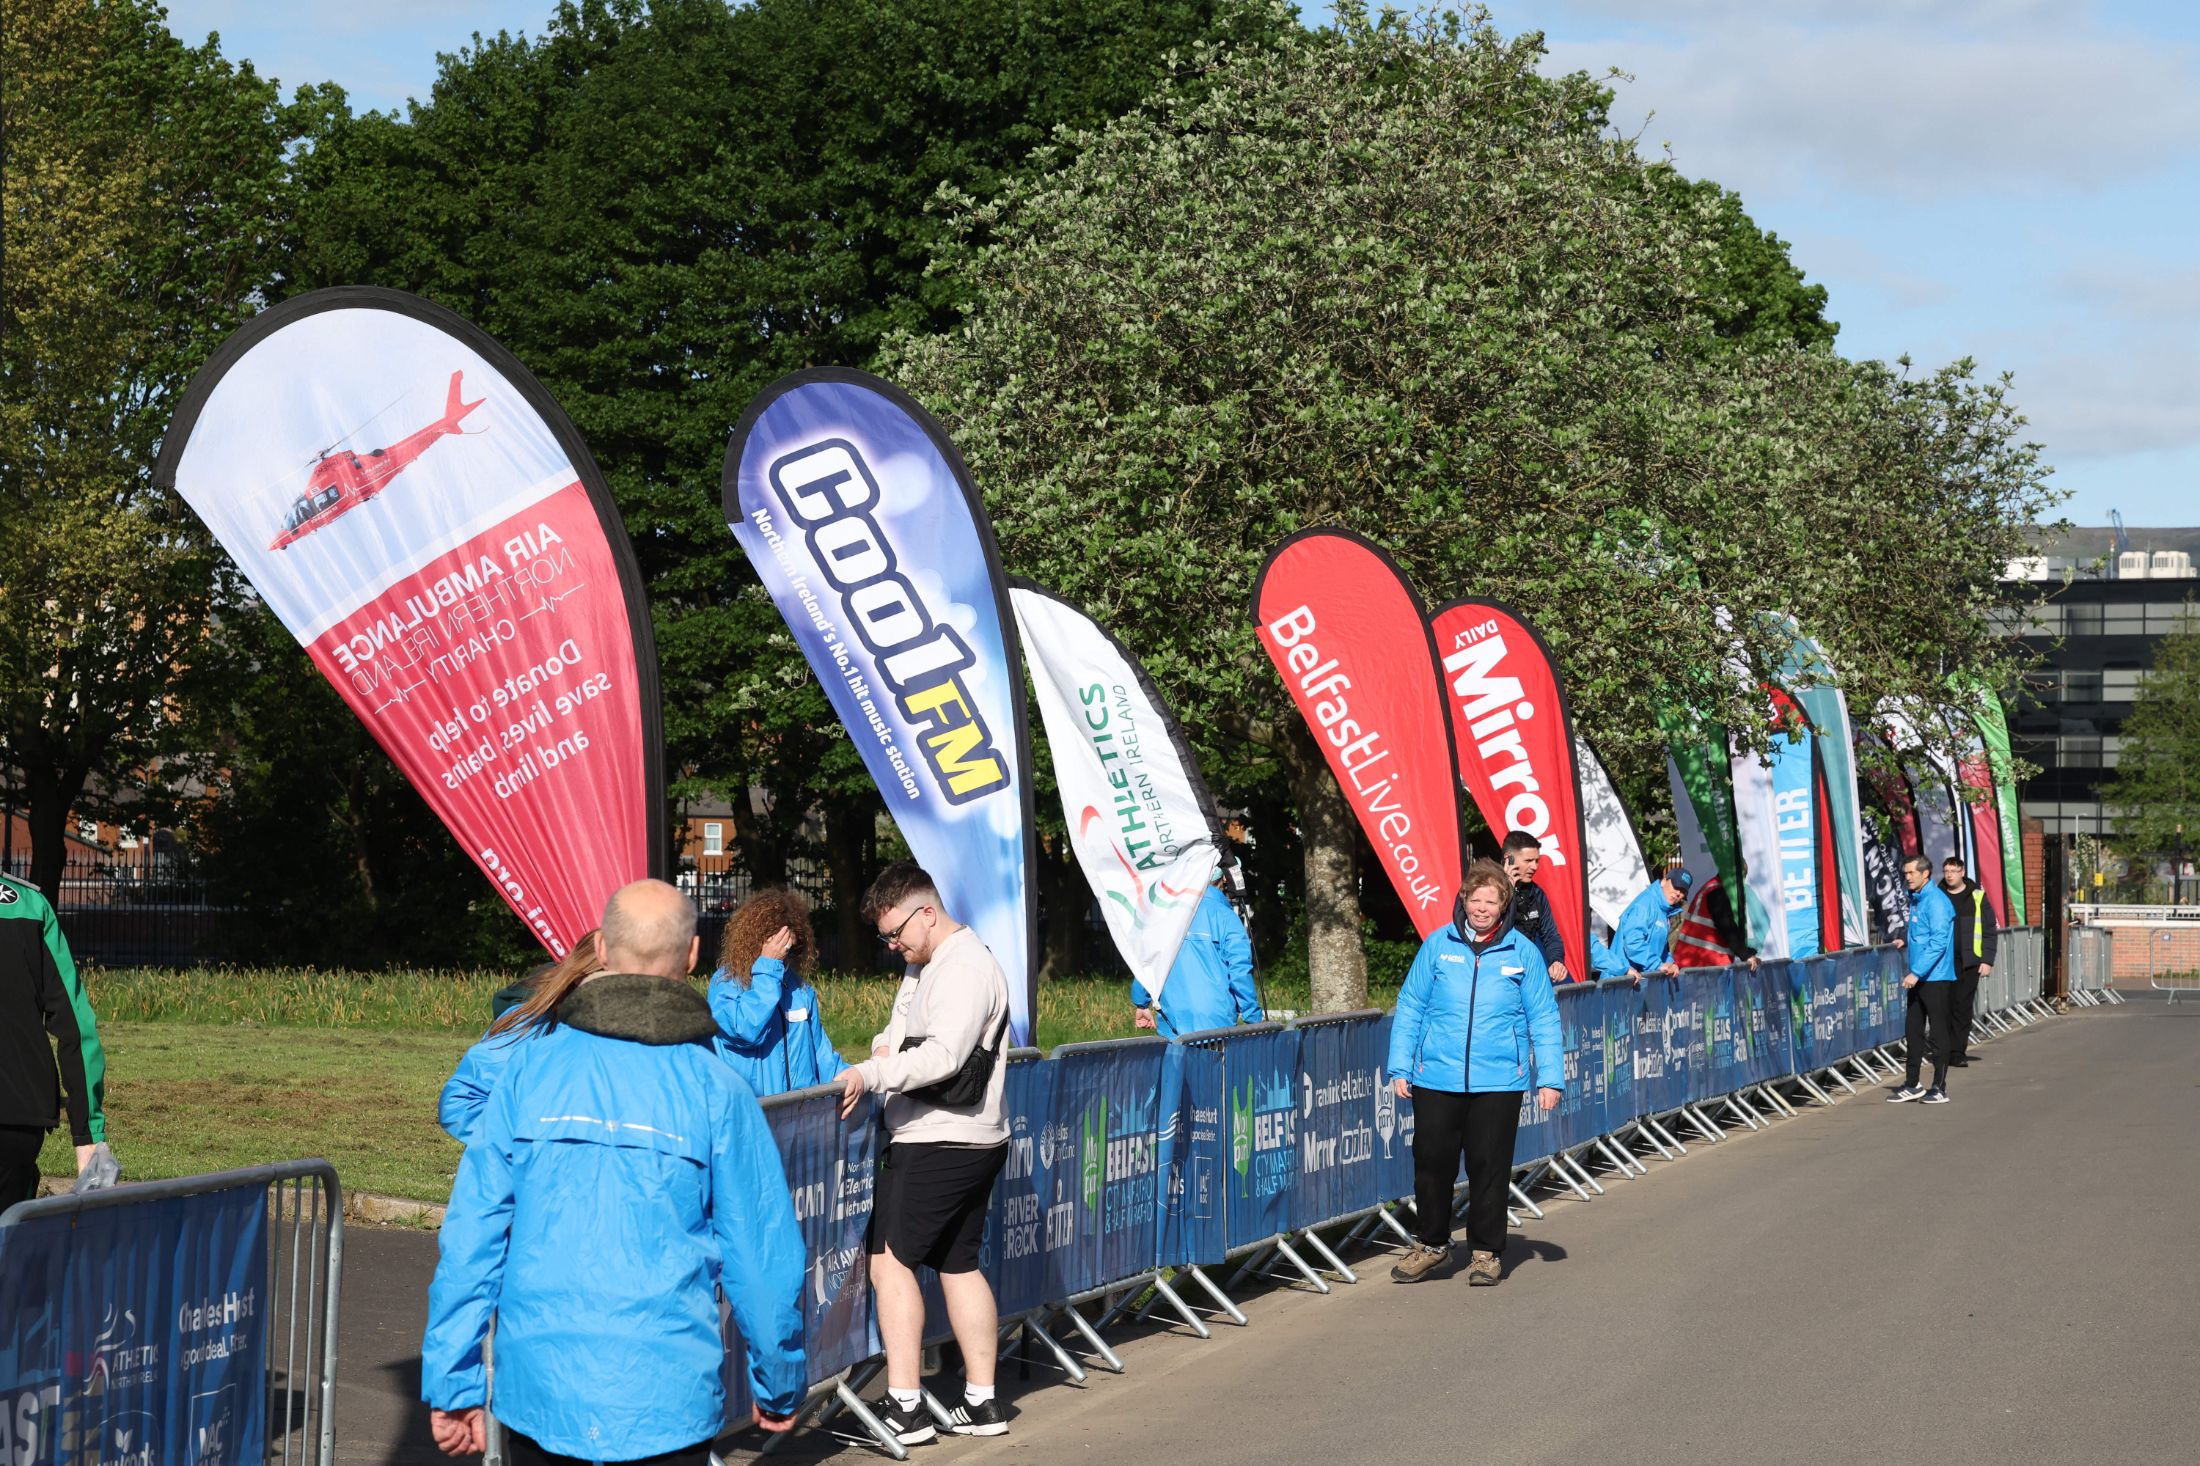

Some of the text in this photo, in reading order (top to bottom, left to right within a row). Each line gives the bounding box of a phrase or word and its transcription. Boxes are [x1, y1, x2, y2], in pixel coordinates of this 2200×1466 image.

[751, 508, 921, 800] Northern Ireland's No.1 hit music station
[1454, 618, 1499, 650] DAILY
[1079, 682, 1165, 872] ATHLETICS
[1112, 684, 1180, 858] ORTHERN IRELAND
[1269, 604, 1439, 910] BelfastLive.co.uk
[1443, 635, 1566, 867] Mirror
[1006, 1222, 1039, 1261] ROCK
[1007, 1193, 1040, 1227] RIVER
